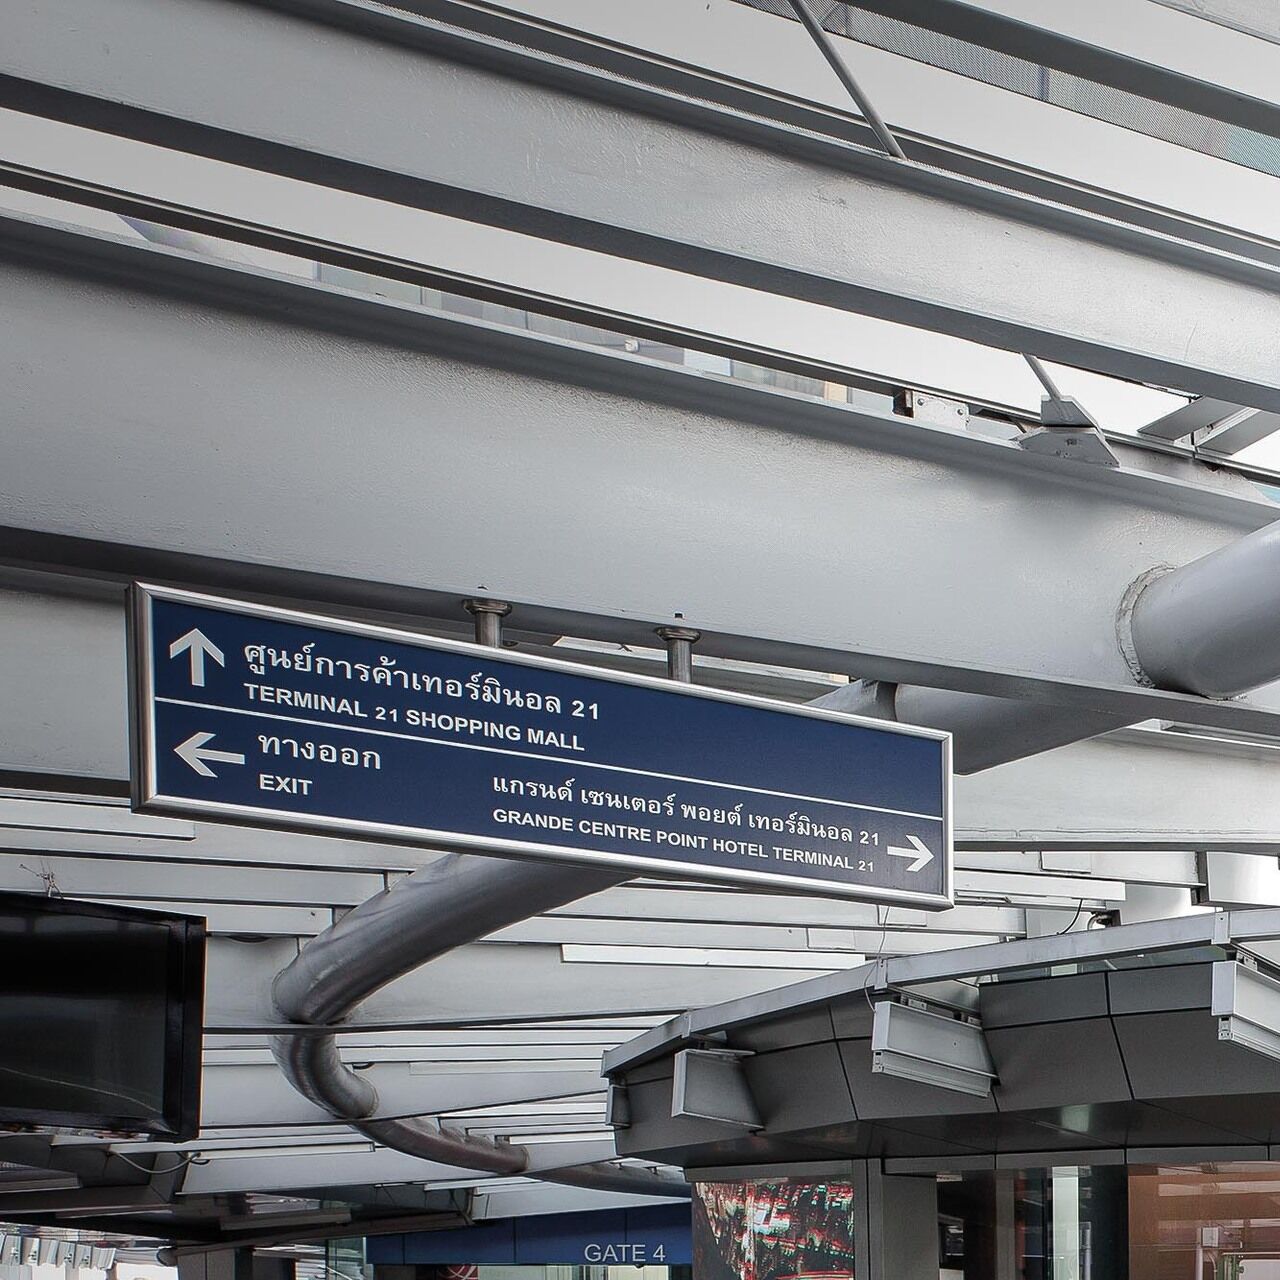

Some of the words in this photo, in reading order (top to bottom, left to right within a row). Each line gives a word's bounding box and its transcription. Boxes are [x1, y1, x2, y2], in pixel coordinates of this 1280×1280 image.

[244, 642, 562, 714] ศูนย์การค้าเทอร์มินอล
[571, 700, 599, 720] 21
[243, 682, 368, 718] TERMINAL
[375, 706, 398, 722] 21
[406, 709, 521, 741] SHOPPING
[527, 728, 585, 751] MALL
[258, 735, 381, 769] ทางออก
[259, 774, 313, 795] EXIT
[493, 776, 576, 802] แกรนด์
[581, 789, 677, 816] เซนเตอร์
[680, 803, 743, 826] พอยต์
[748, 812, 852, 842] เทอร์มินอล
[859, 831, 879, 846] 21
[493, 809, 574, 832] GRANDE
[578, 820, 651, 842] CENTRE
[656, 830, 708, 850] POINT
[712, 838, 768, 858] HOTEL
[773, 846, 854, 870] TERMINAL
[858, 860, 874, 873] 21
[584, 1243, 646, 1262] GATE
[652, 1244, 666, 1262] 4
